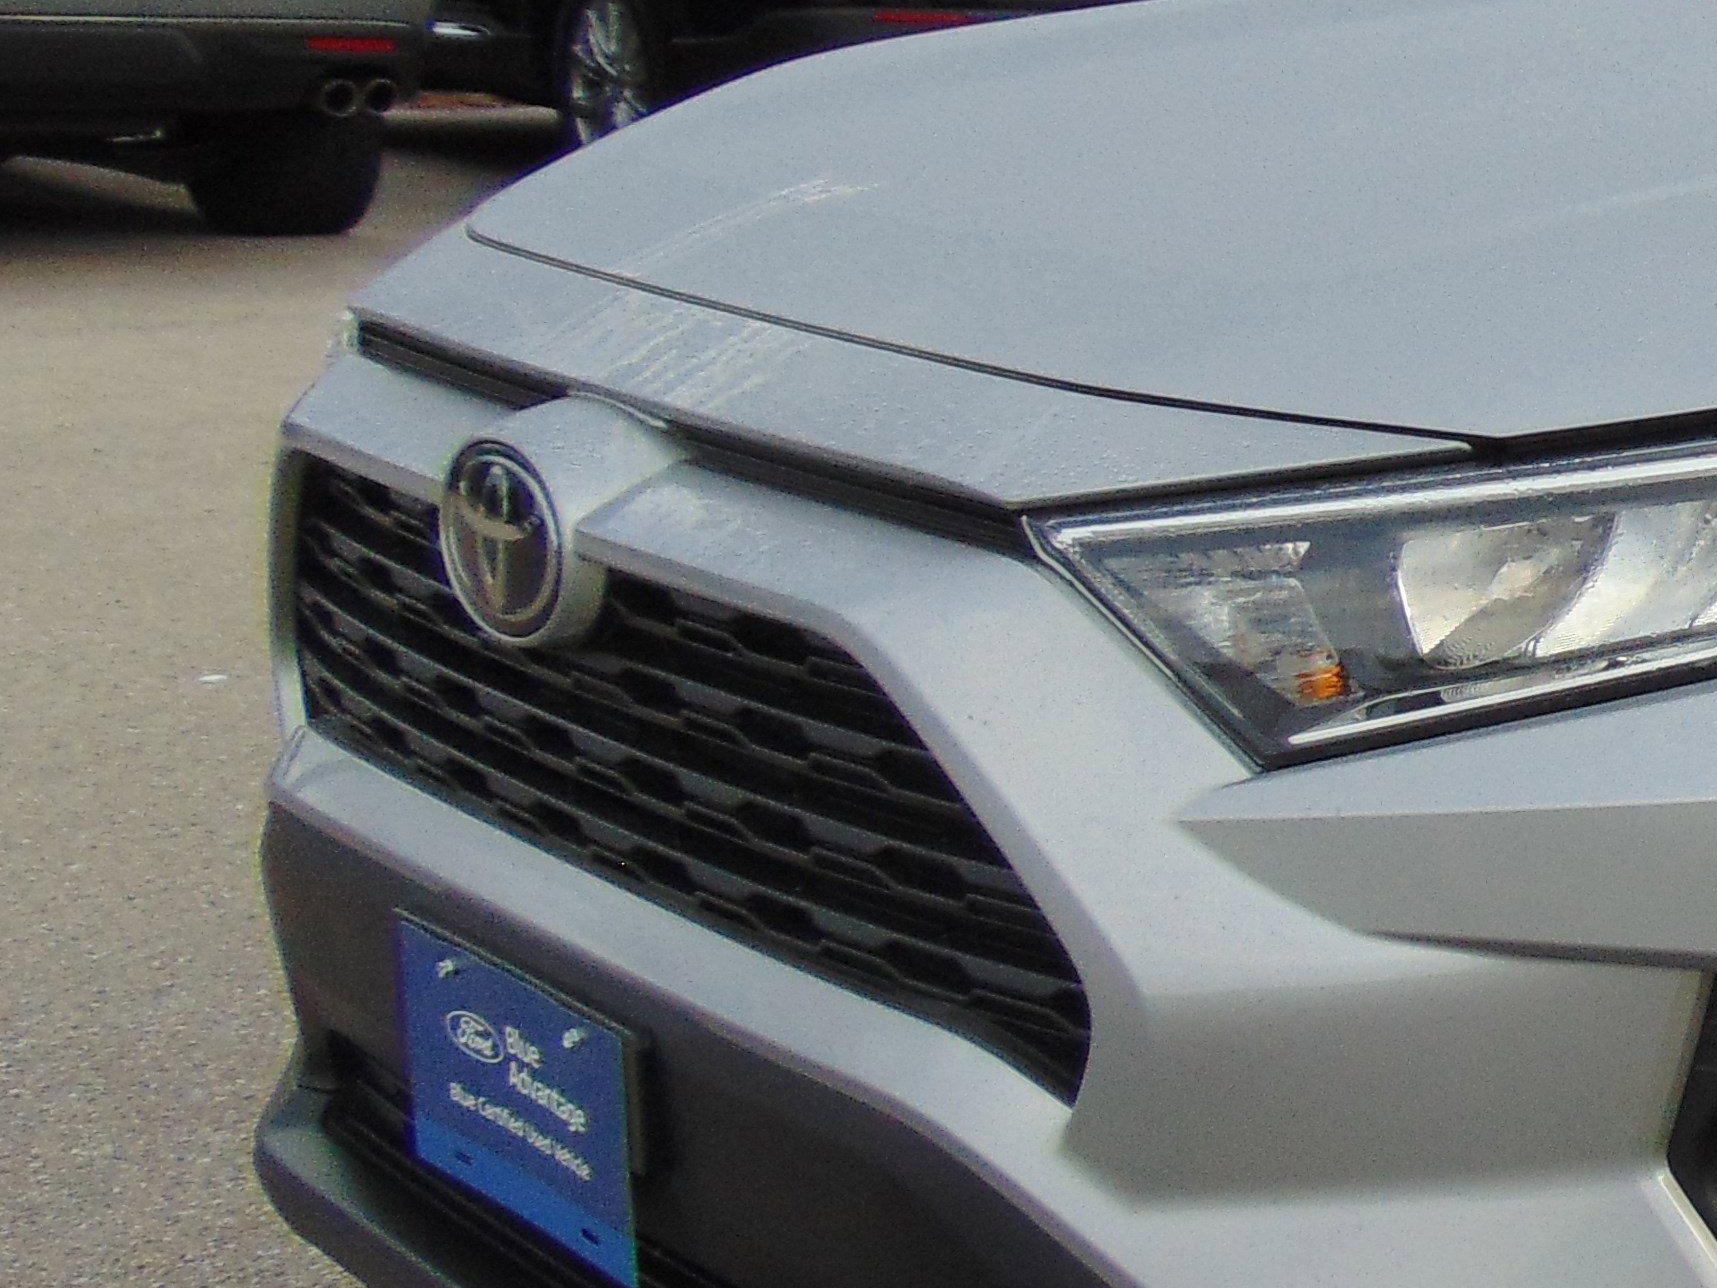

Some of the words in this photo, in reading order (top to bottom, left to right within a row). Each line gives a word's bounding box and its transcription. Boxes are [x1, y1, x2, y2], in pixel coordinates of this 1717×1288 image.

[457, 1016, 496, 1056] Ford
[505, 1026, 543, 1069] Blue
[450, 1082, 478, 1110] Blue
[509, 1060, 588, 1132] Advantage
